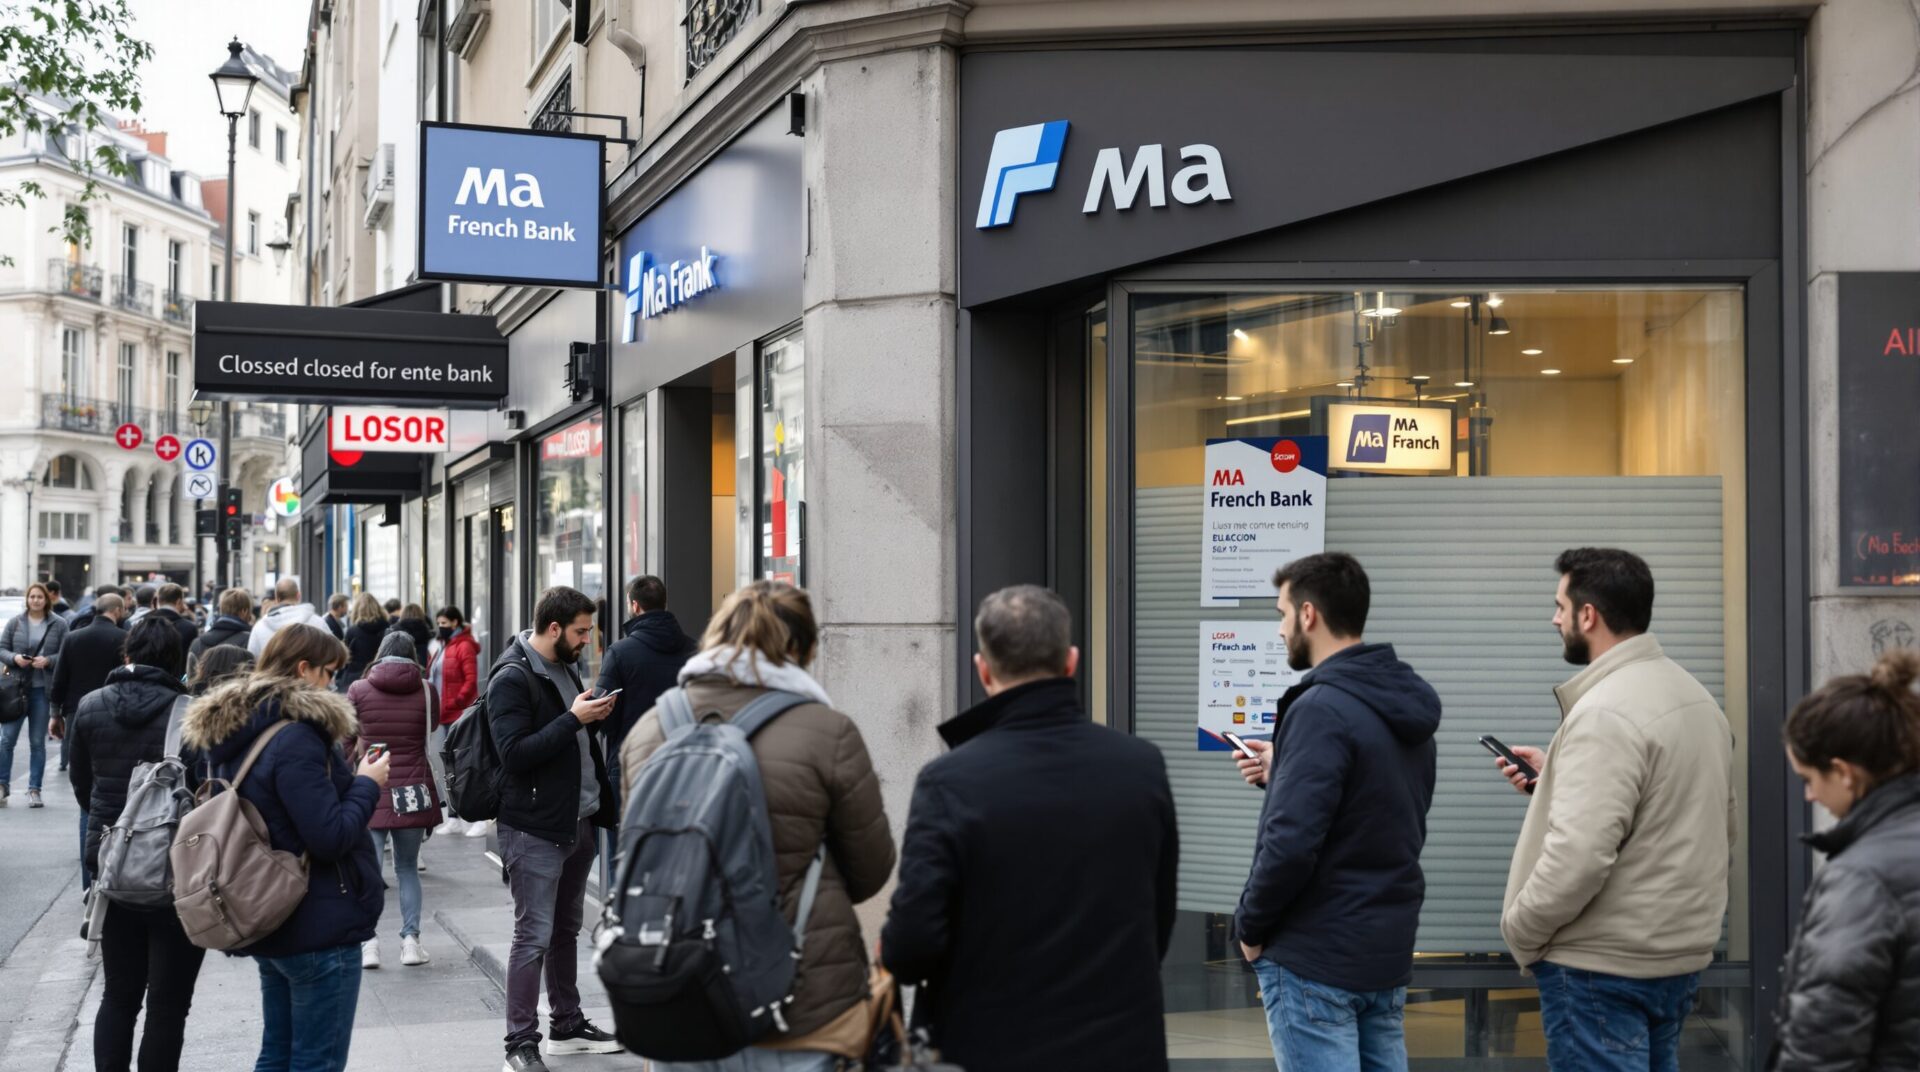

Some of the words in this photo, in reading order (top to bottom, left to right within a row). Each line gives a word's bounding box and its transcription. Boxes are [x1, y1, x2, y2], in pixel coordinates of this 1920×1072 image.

[454, 166, 544, 208] Ma
[1082, 143, 1232, 214] Ma
[448, 214, 518, 238] French
[524, 220, 576, 242] Bank
[641, 264, 667, 320] Ma
[670, 246, 718, 305] Frank
[218, 354, 298, 376] Clossed
[303, 359, 364, 379] closed
[370, 361, 396, 379] for
[401, 366, 442, 381] ente
[447, 363, 493, 383] bank
[344, 414, 445, 443] LOSOR
[1393, 418, 1418, 432] MA
[1352, 430, 1384, 457] Ma
[1392, 435, 1440, 450] Franch
[1212, 469, 1245, 486] MA
[1210, 490, 1266, 508] French
[1270, 490, 1313, 507] Bank
